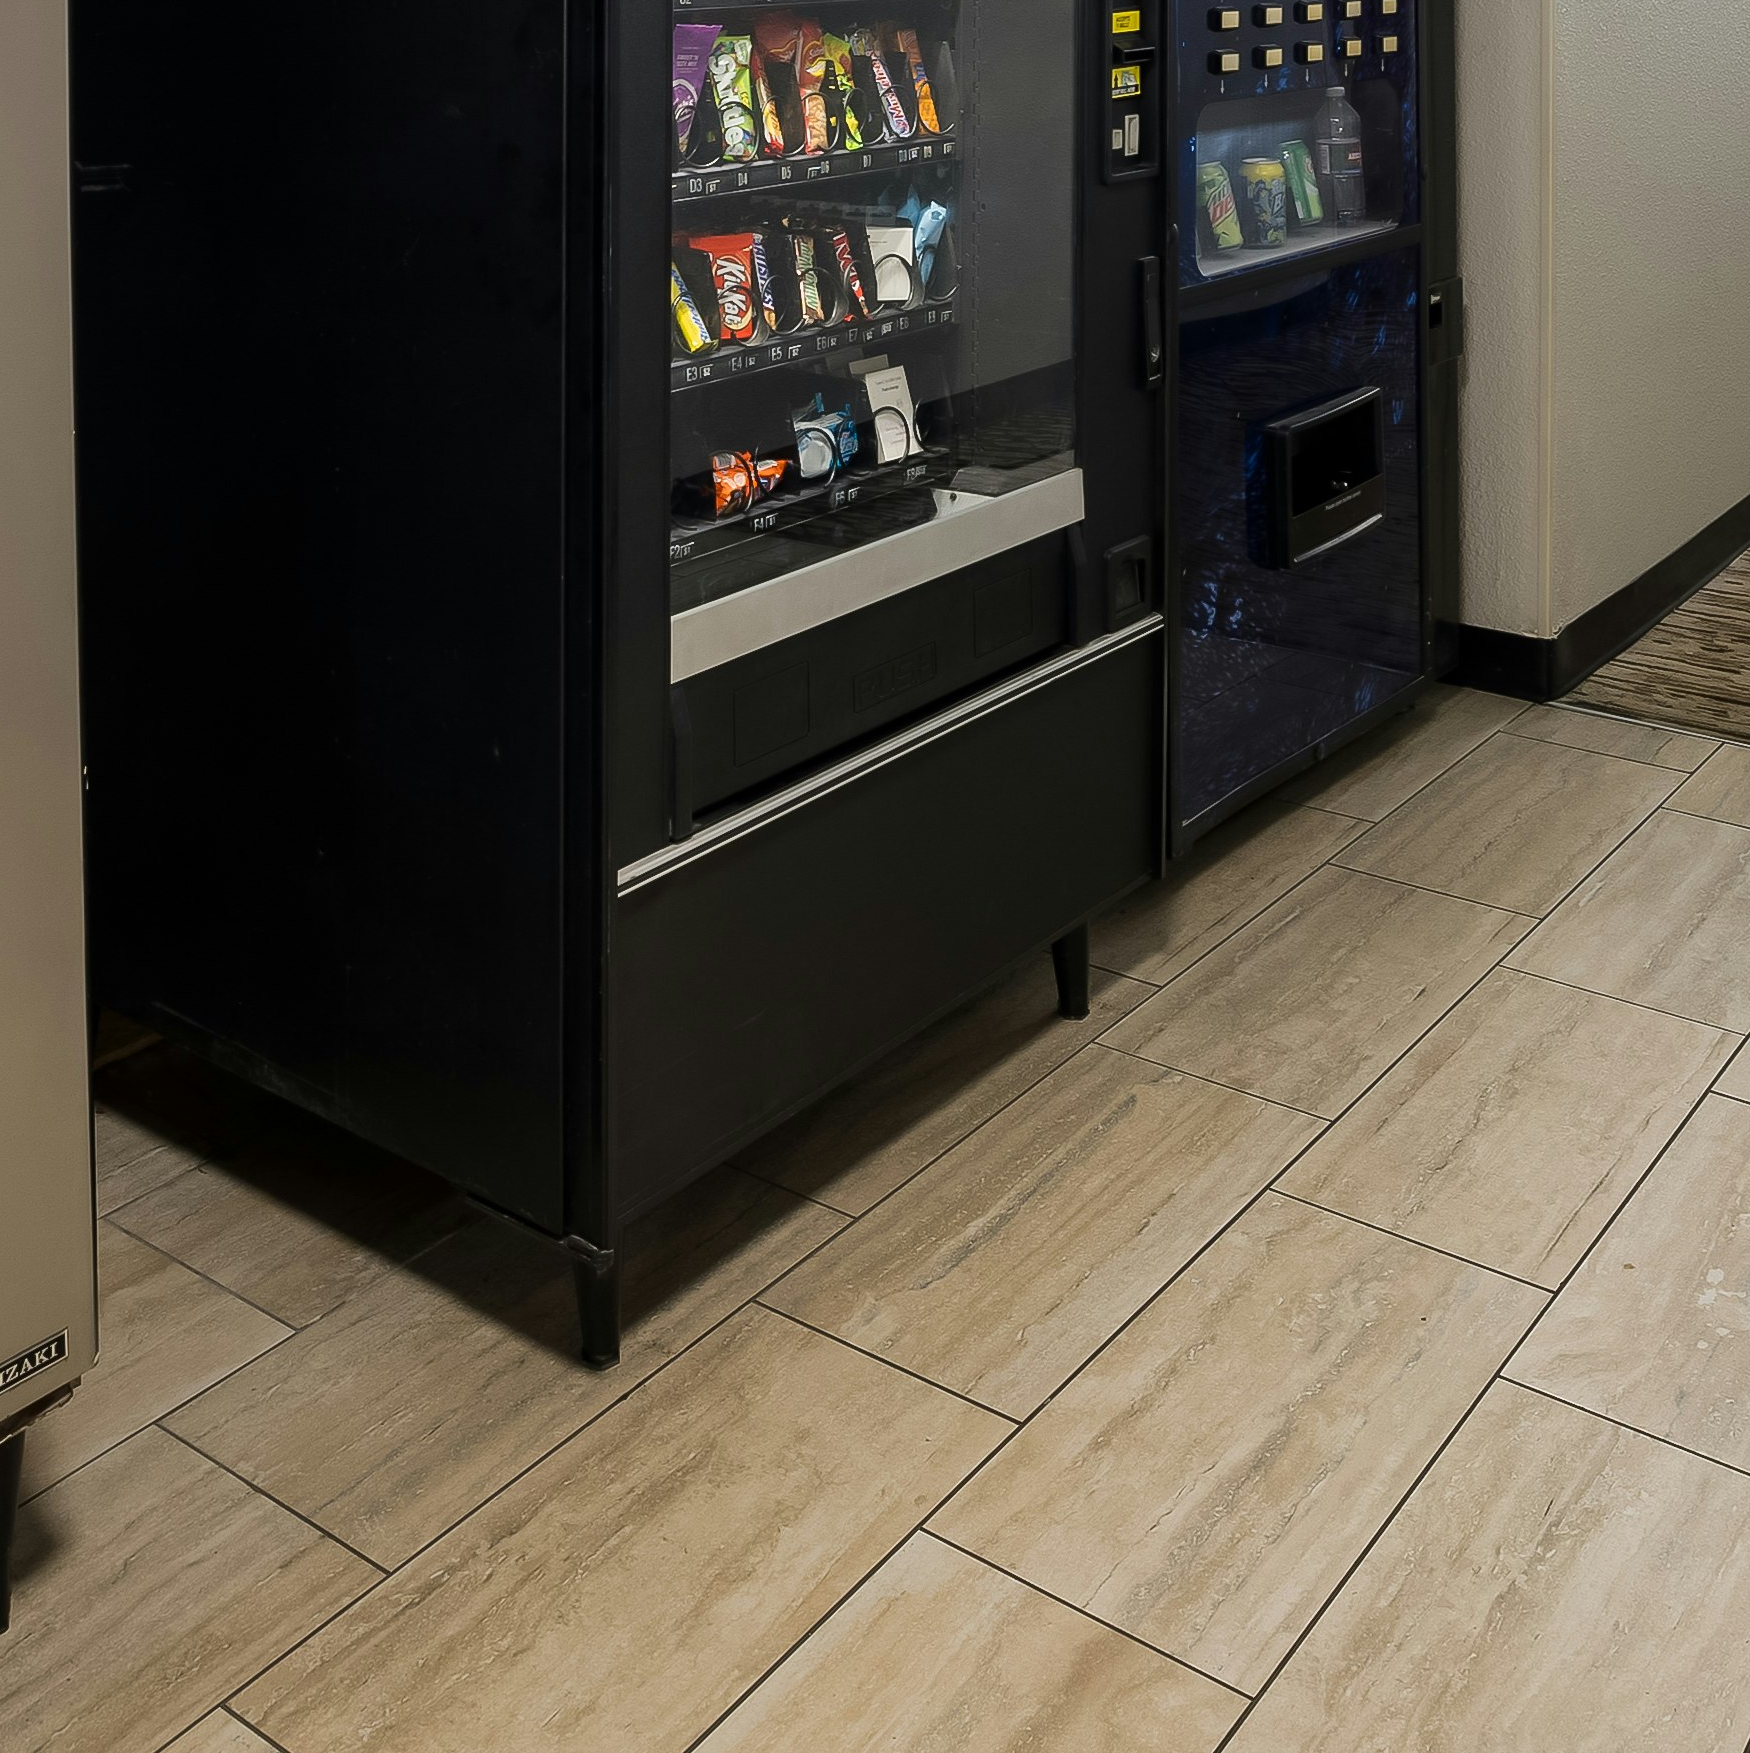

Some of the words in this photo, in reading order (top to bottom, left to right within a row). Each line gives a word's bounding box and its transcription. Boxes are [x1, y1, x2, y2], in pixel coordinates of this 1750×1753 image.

[738, 173, 748, 186] D4
[781, 166, 792, 179] D5
[690, 178, 703, 193] D3
[772, 347, 782, 361] E5
[731, 357, 743, 371] E4
[686, 367, 697, 382] E3
